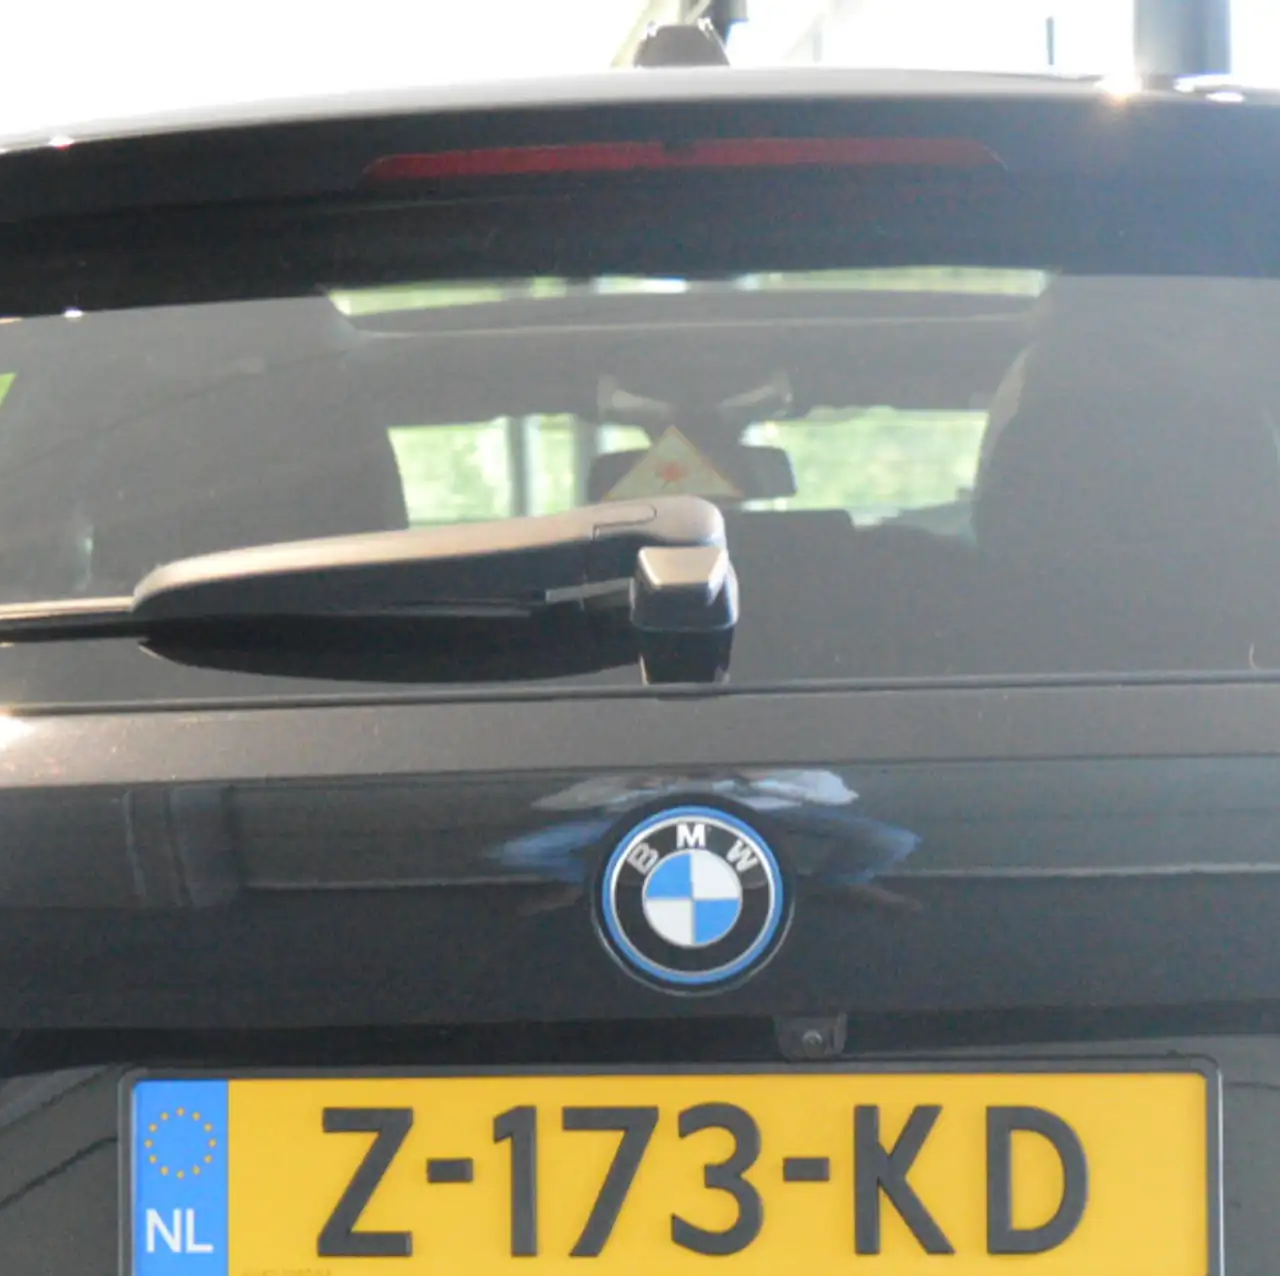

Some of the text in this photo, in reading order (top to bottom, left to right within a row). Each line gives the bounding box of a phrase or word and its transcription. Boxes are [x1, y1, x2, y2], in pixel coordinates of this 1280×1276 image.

[627, 823, 758, 874] BMW
[317, 1102, 1087, 1258] Z-173-KD
[147, 1208, 214, 1254] NL
